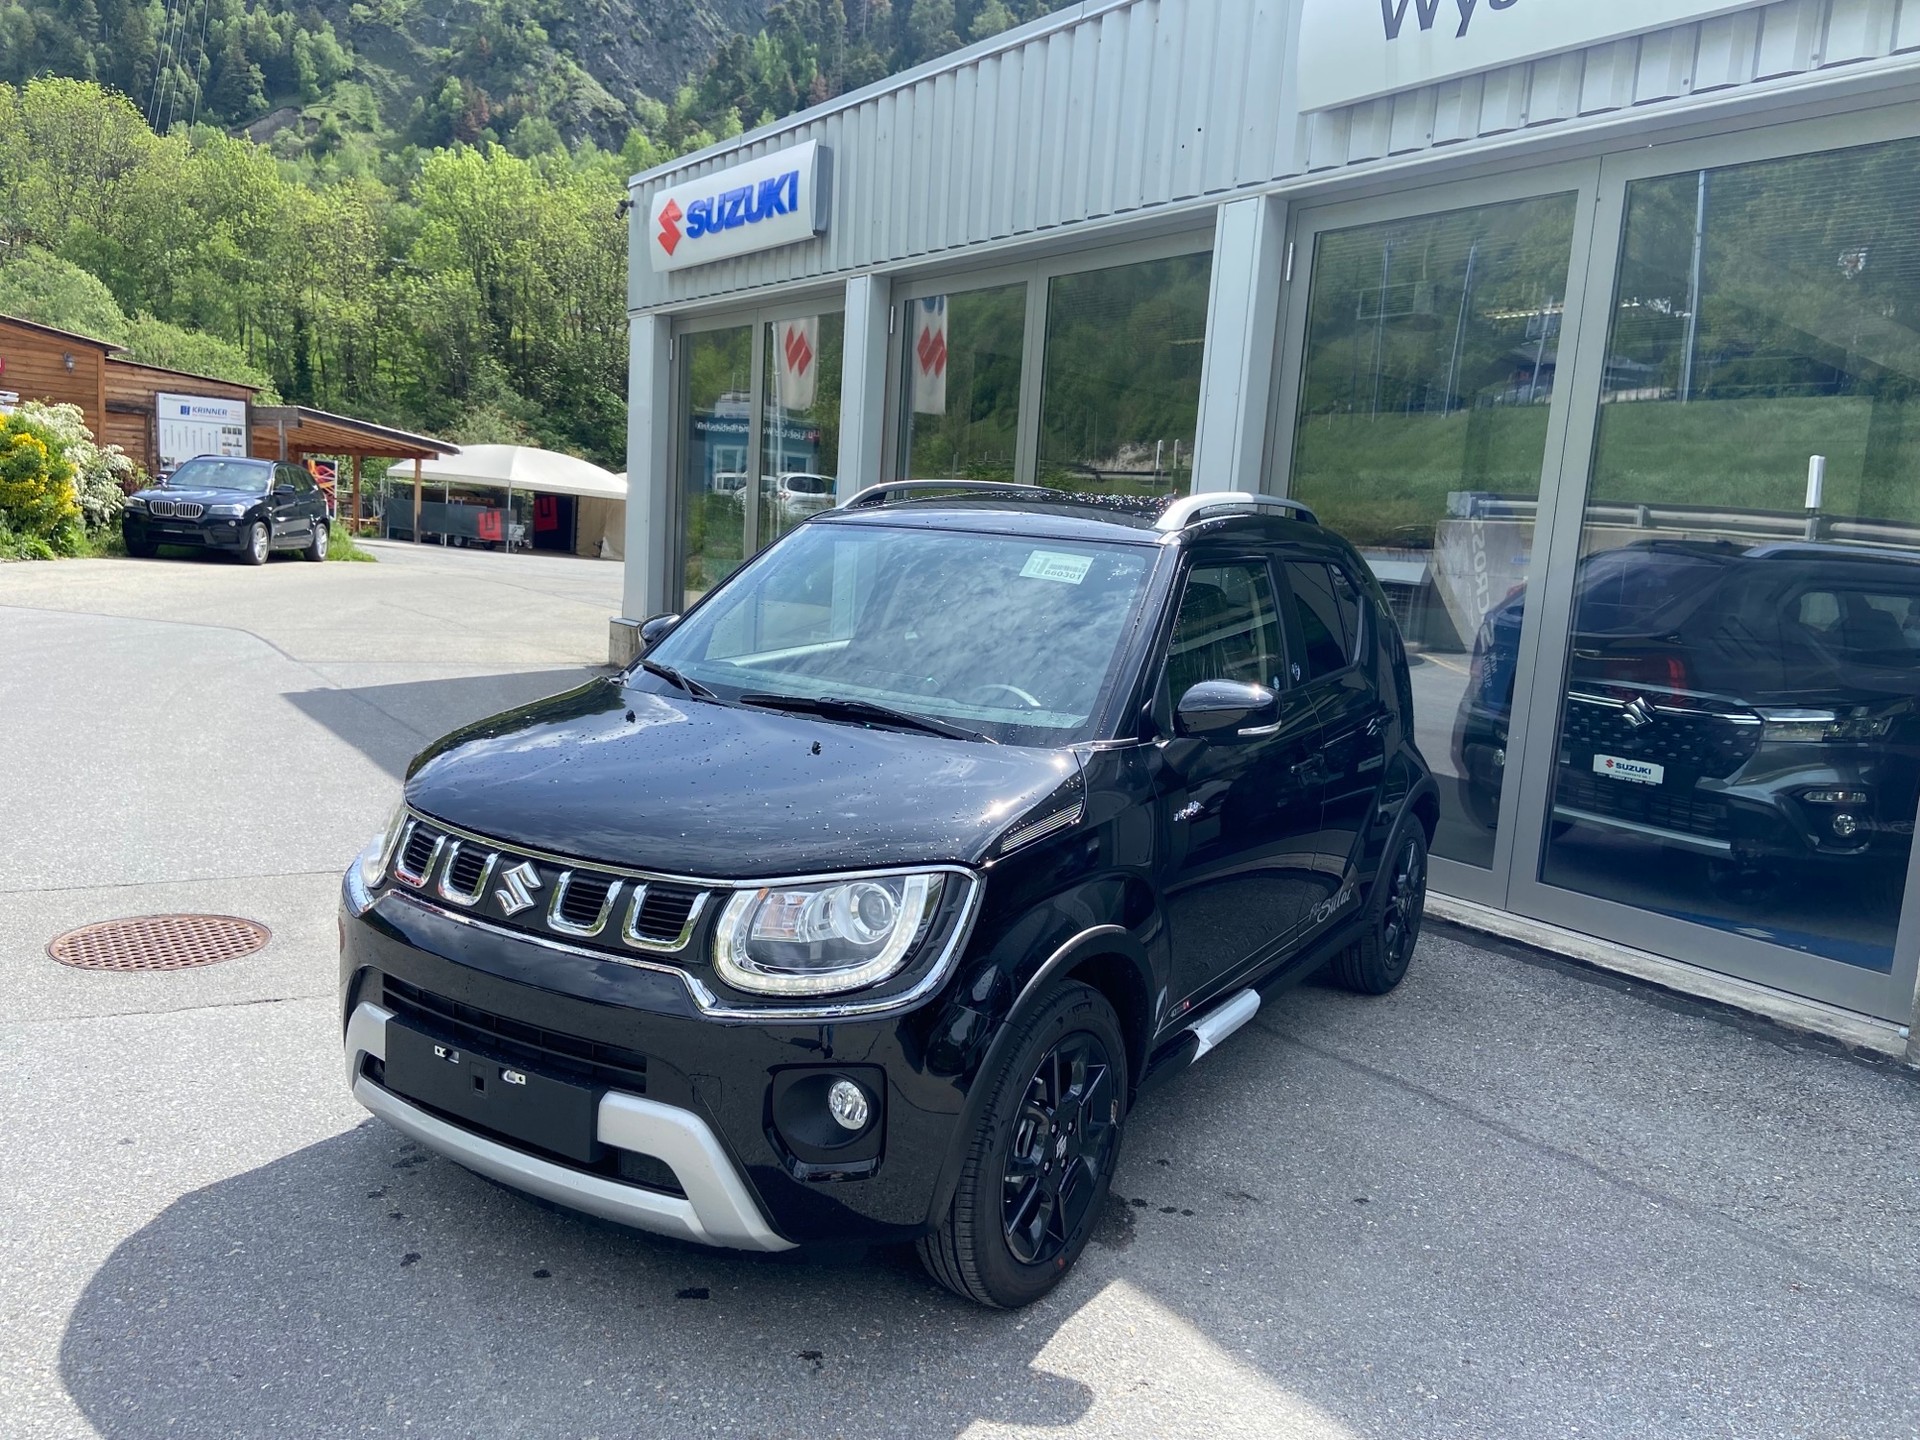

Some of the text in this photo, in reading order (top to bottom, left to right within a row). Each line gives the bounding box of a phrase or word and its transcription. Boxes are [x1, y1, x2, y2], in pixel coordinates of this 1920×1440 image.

[686, 170, 799, 239] SUZUKI
[192, 406, 228, 416] KRINNER
[1616, 762, 1651, 775] SUZUKI
